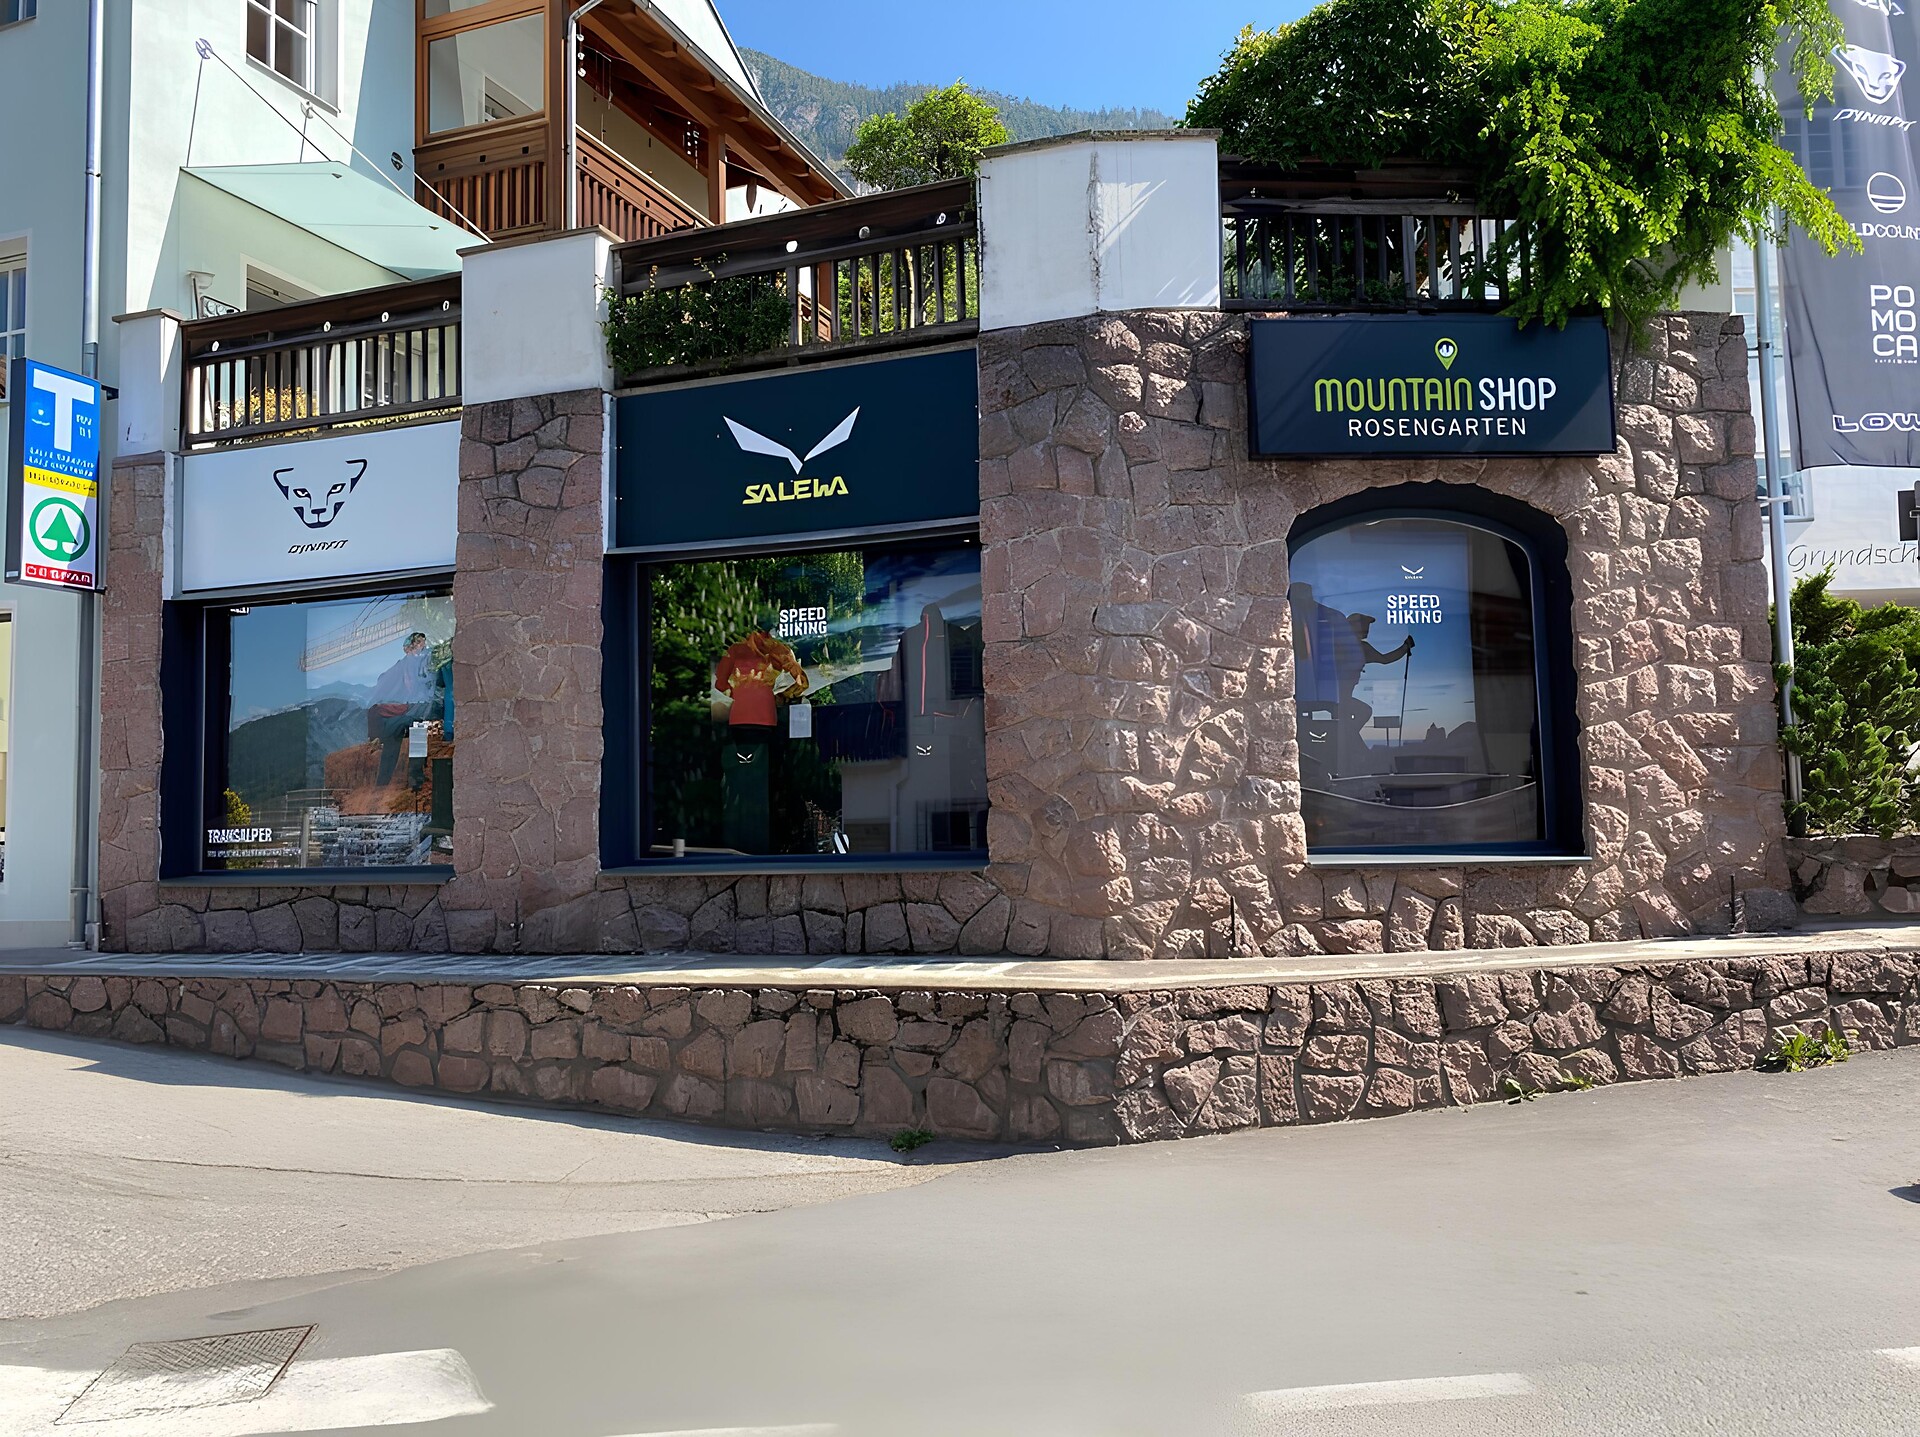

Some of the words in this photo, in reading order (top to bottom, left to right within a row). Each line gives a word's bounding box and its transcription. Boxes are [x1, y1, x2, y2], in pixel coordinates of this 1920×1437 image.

[1849, 222, 1920, 240] LDCOUN
[1870, 284, 1915, 308] PO
[1871, 308, 1917, 332] MO
[1872, 333, 1918, 358] CA
[1314, 377, 1473, 412] MOUNTAIN
[1478, 377, 1557, 411] SHOP
[1348, 417, 1526, 437] ROSENGARTEN
[1832, 412, 1920, 433] LOW
[742, 475, 849, 505] SALEWA
[1787, 543, 1917, 573] Grundsch
[1387, 594, 1440, 609] SPEED
[779, 606, 826, 623] SPEED
[1386, 609, 1442, 625] HIKING
[778, 620, 828, 638] HIKING
